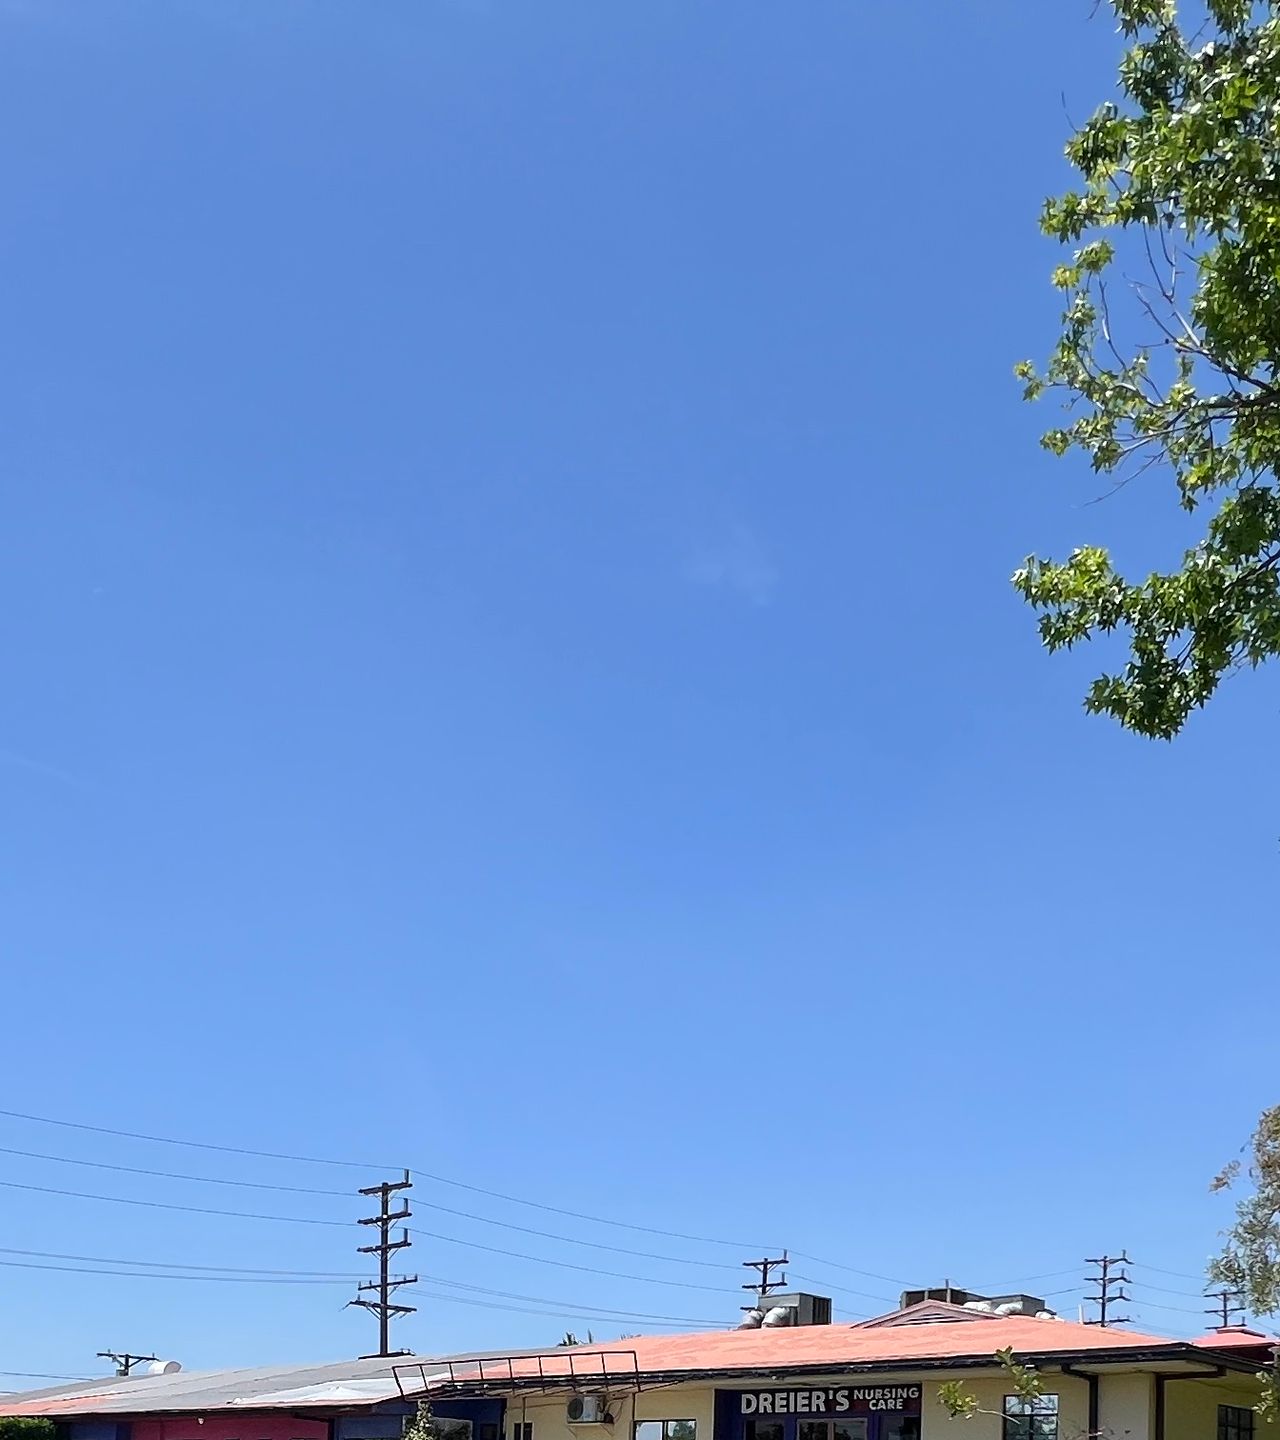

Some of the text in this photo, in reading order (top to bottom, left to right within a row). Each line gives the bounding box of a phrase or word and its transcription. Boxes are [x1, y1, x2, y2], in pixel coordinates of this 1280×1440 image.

[740, 1387, 919, 1414] DREIER'S NURSING
[868, 1399, 904, 1410] CARE
